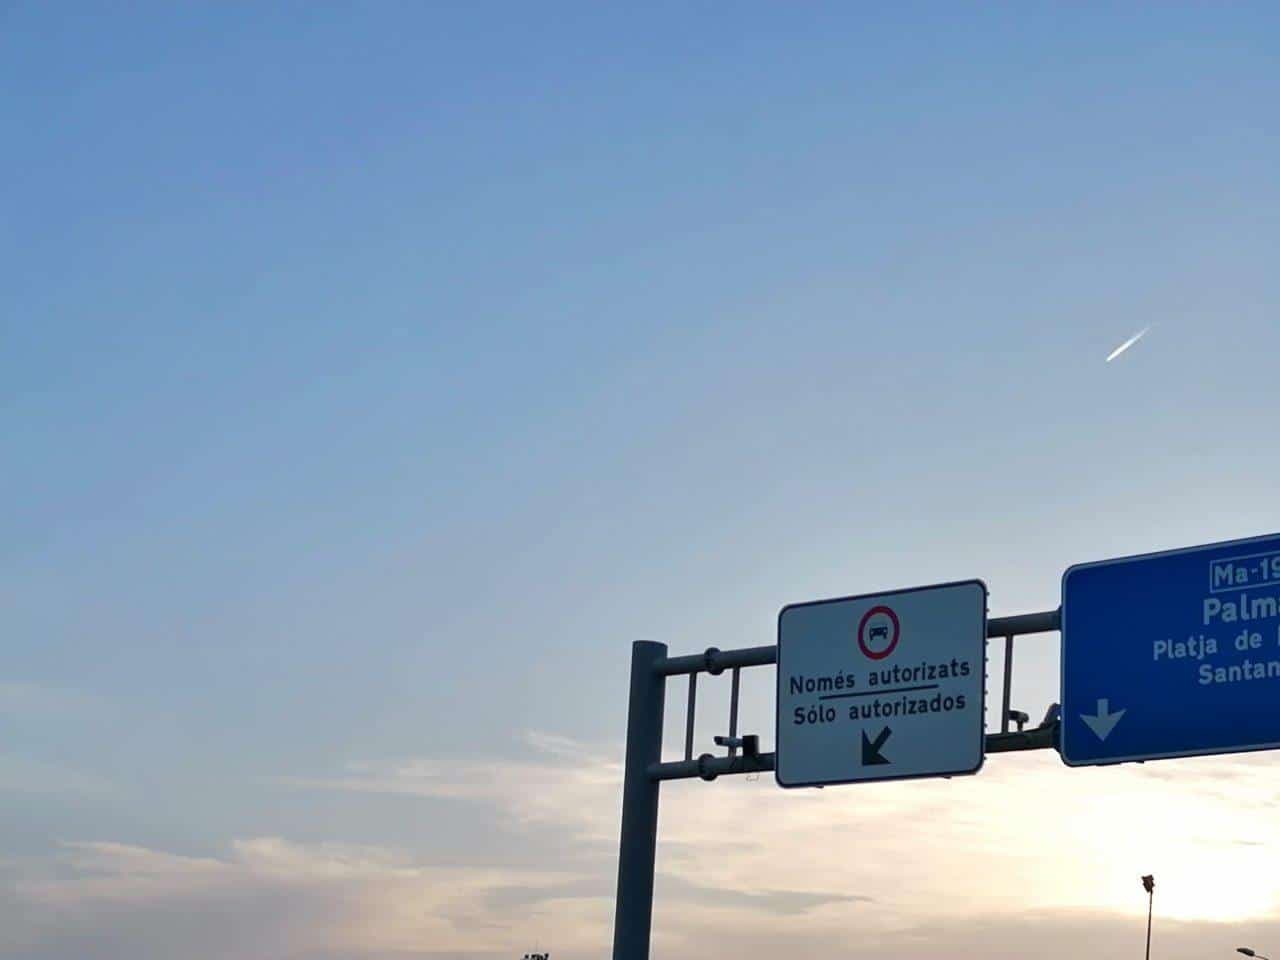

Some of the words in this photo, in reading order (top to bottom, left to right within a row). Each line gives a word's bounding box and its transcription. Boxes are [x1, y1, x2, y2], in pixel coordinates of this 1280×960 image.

[1153, 636, 1217, 661] Platja
[1235, 629, 1262, 651] de
[790, 669, 855, 695] Només
[868, 658, 970, 686] autorizats
[793, 704, 836, 725] Sólo
[849, 692, 966, 720] autorizados
